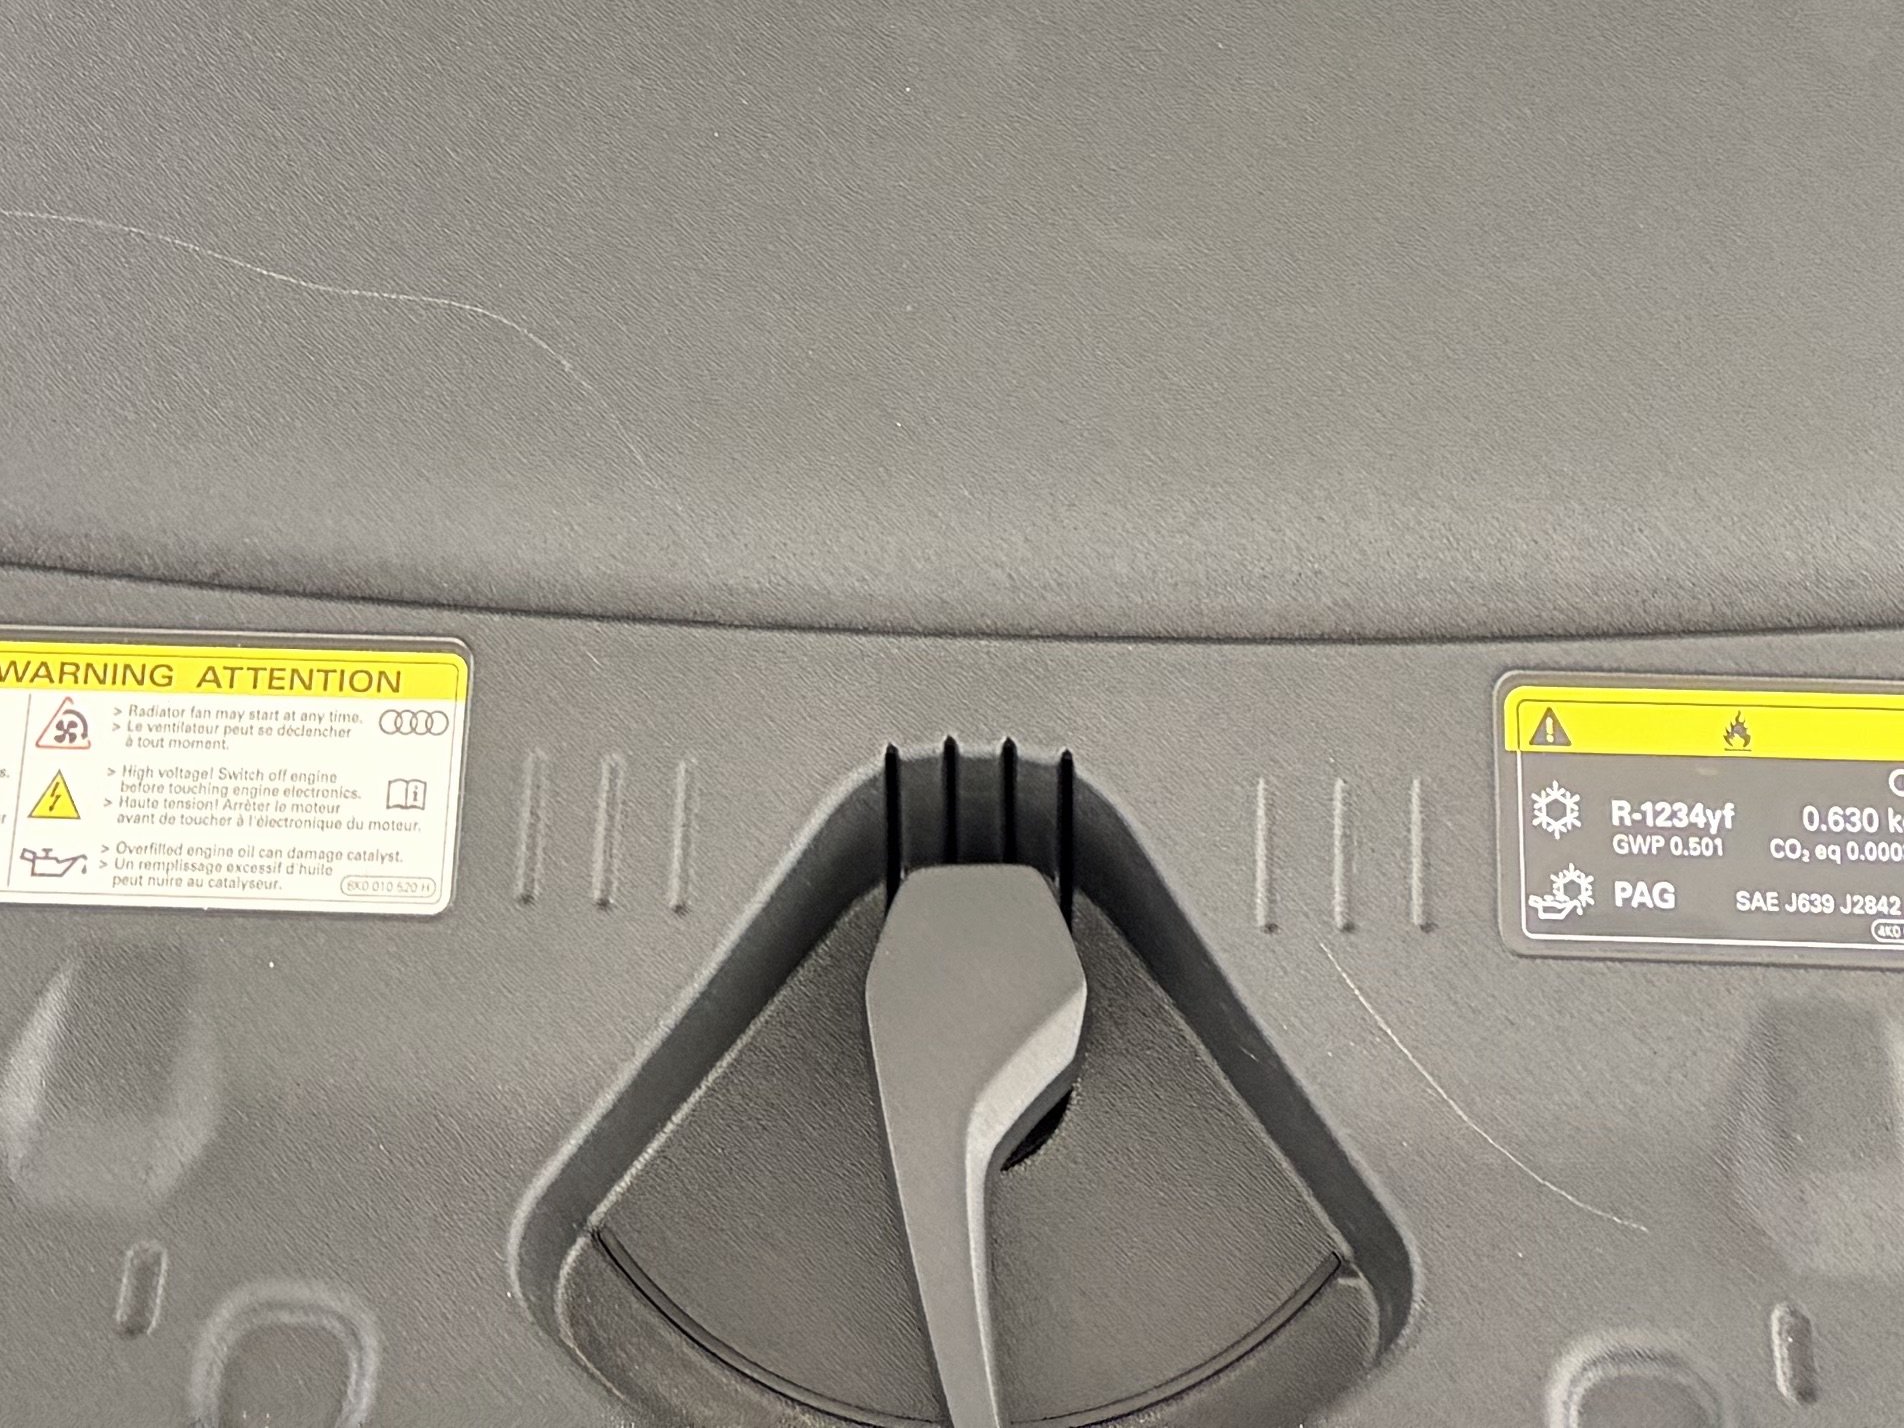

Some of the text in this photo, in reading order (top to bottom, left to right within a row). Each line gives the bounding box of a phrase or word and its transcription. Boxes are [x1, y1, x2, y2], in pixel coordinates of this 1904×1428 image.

[196, 666, 400, 693] ATTENTION
[129, 704, 362, 724] Radiator fan may start at any time.
[127, 720, 142, 732] Le
[147, 721, 219, 734] ventilateur
[224, 725, 253, 737] peut
[258, 726, 273, 736] se
[138, 737, 164, 748] tout
[169, 739, 228, 750] moment.
[121, 765, 337, 785] High voltage! Switch off engine
[121, 780, 361, 799] before touching engine electronics.
[119, 795, 158, 809] Haute
[164, 797, 218, 811] tension!
[275, 800, 286, 812] le
[291, 802, 340, 814] moteur
[117, 814, 155, 824] avant
[159, 812, 176, 825] de
[180, 813, 232, 826] toucher
[347, 817, 363, 830] du
[369, 821, 420, 832] moteur.
[1612, 800, 1735, 834] R-1234yf
[1803, 806, 1879, 833] 0.630
[116, 841, 403, 864] Overfilled engine oil can damage catalyst.
[1613, 834, 1723, 856] GWP 0.501
[1815, 844, 1841, 864] eq
[115, 858, 133, 870] Un
[139, 859, 222, 874] remplissage
[227, 861, 282, 874] excessif
[112, 875, 282, 891] peut nuire au catalyseur.
[371, 880, 393, 892] 010
[1615, 881, 1675, 908] PAG
[1736, 891, 1779, 911] SAE
[1785, 893, 1834, 913] J639
[1840, 894, 1901, 915] J2842
